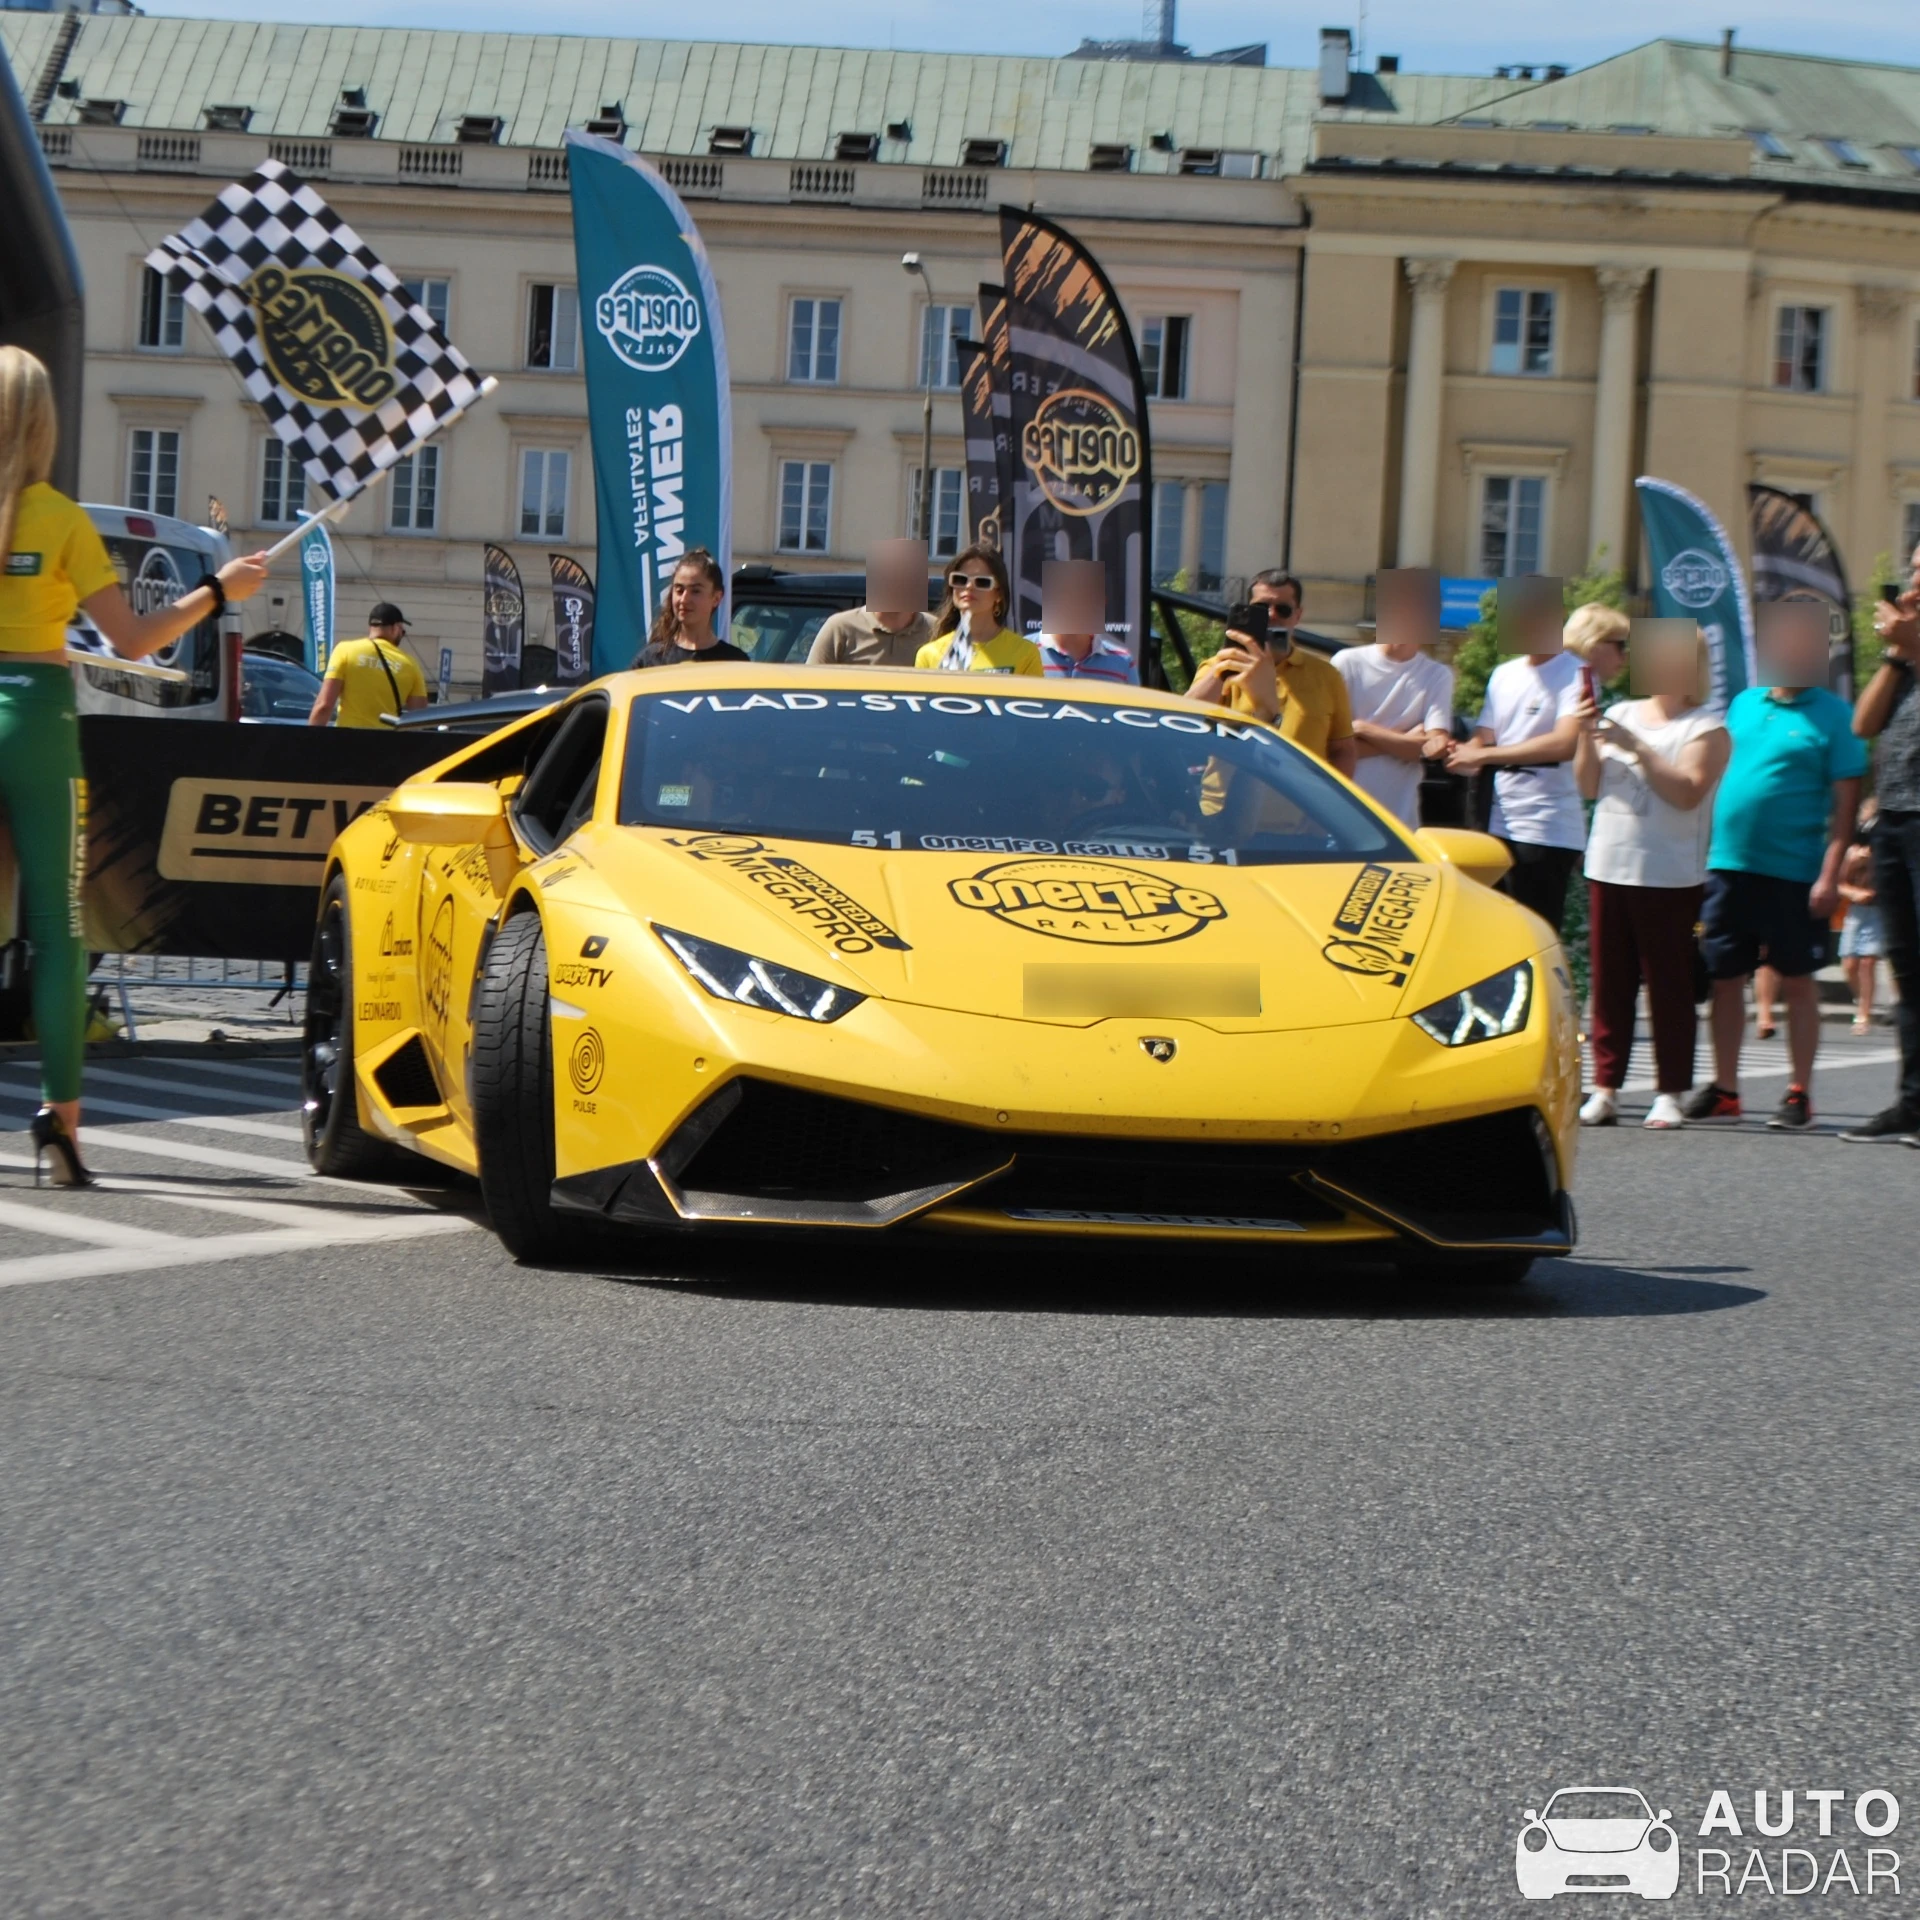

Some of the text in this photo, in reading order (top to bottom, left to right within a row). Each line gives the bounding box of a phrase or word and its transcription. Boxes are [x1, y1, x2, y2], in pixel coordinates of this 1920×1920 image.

[660, 693, 1271, 745] VLAD-STOICA.COM
[851, 830, 901, 849] 51
[1188, 846, 1238, 866] 51
[781, 864, 894, 939] SUPPORTED BY
[1037, 919, 1170, 934] RALLY
[358, 1002, 401, 1021] LEONARDO
[573, 1099, 597, 1115] PULSE
